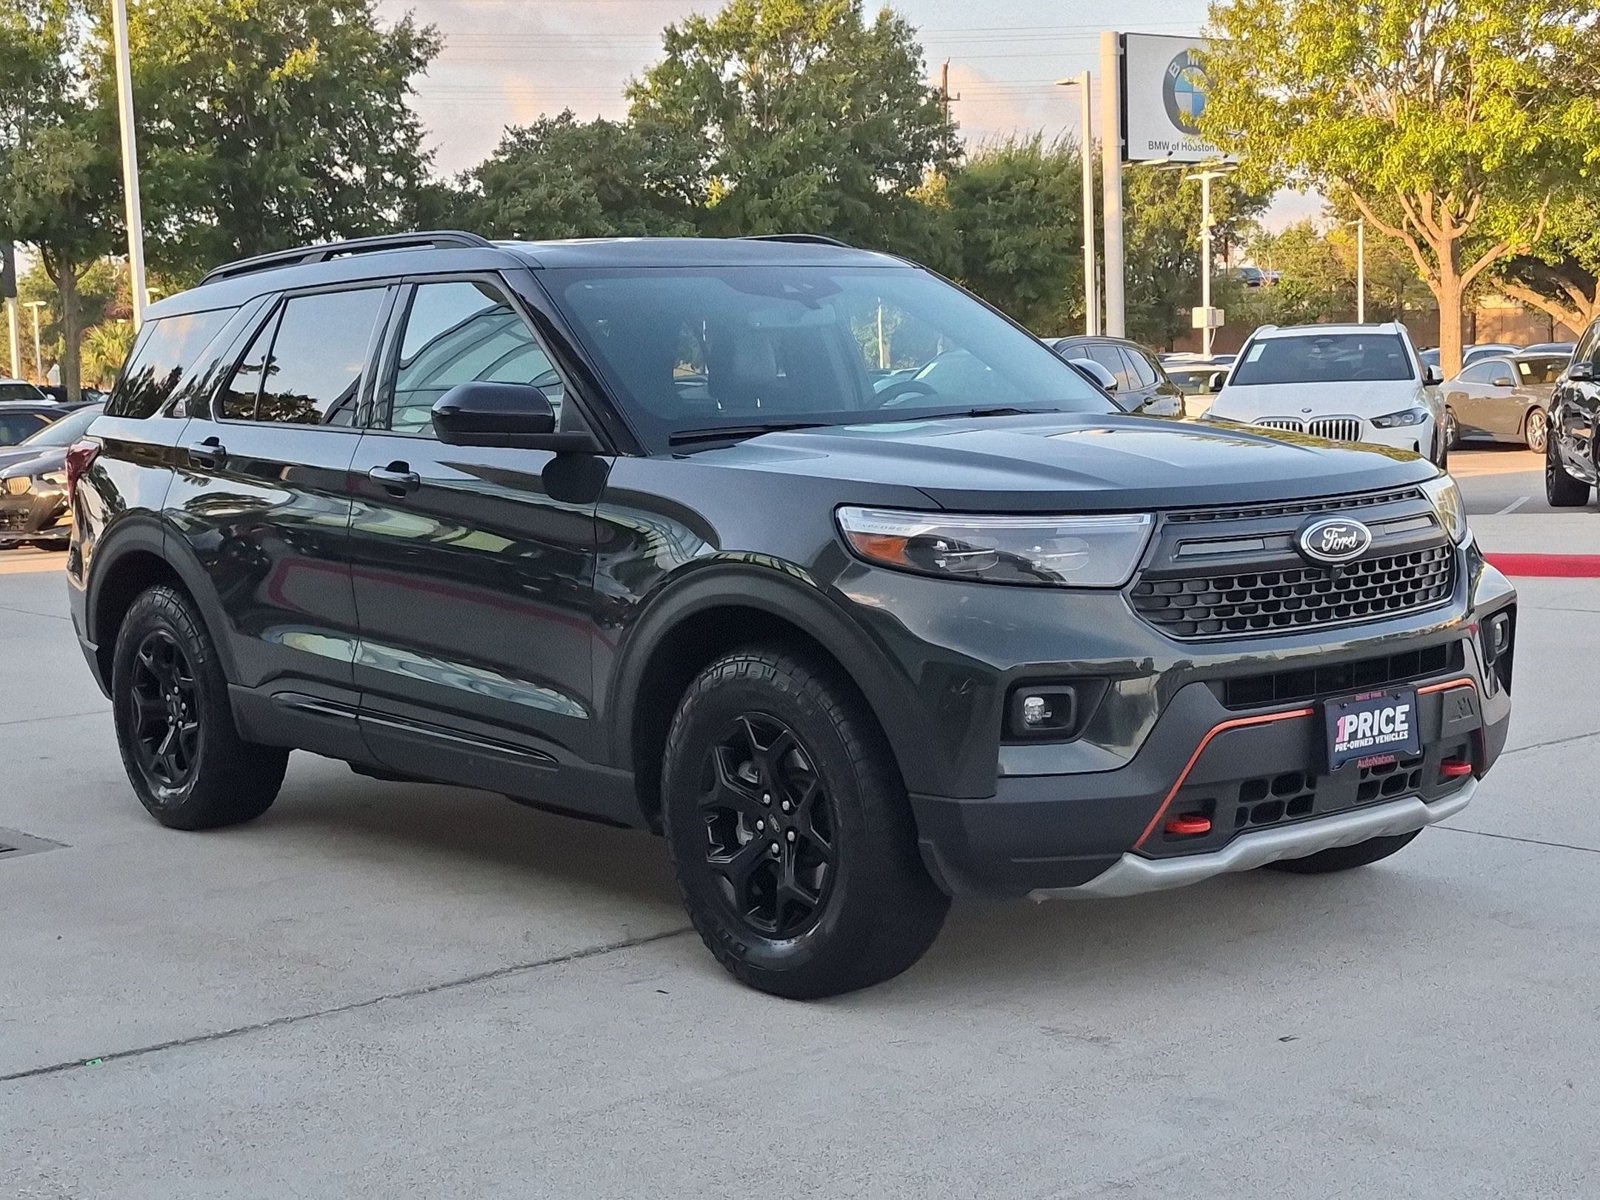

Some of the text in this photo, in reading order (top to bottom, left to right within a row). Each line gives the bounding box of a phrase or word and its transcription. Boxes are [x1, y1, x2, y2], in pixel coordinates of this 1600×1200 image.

[1148, 140, 1170, 151] BMW
[1171, 141, 1180, 151] of
[1181, 141, 1215, 152] Houston
[1321, 526, 1358, 552] Ford
[1334, 730, 1409, 753] PRE-OWNED VEHICLES
[1357, 754, 1395, 769] AutoNation
